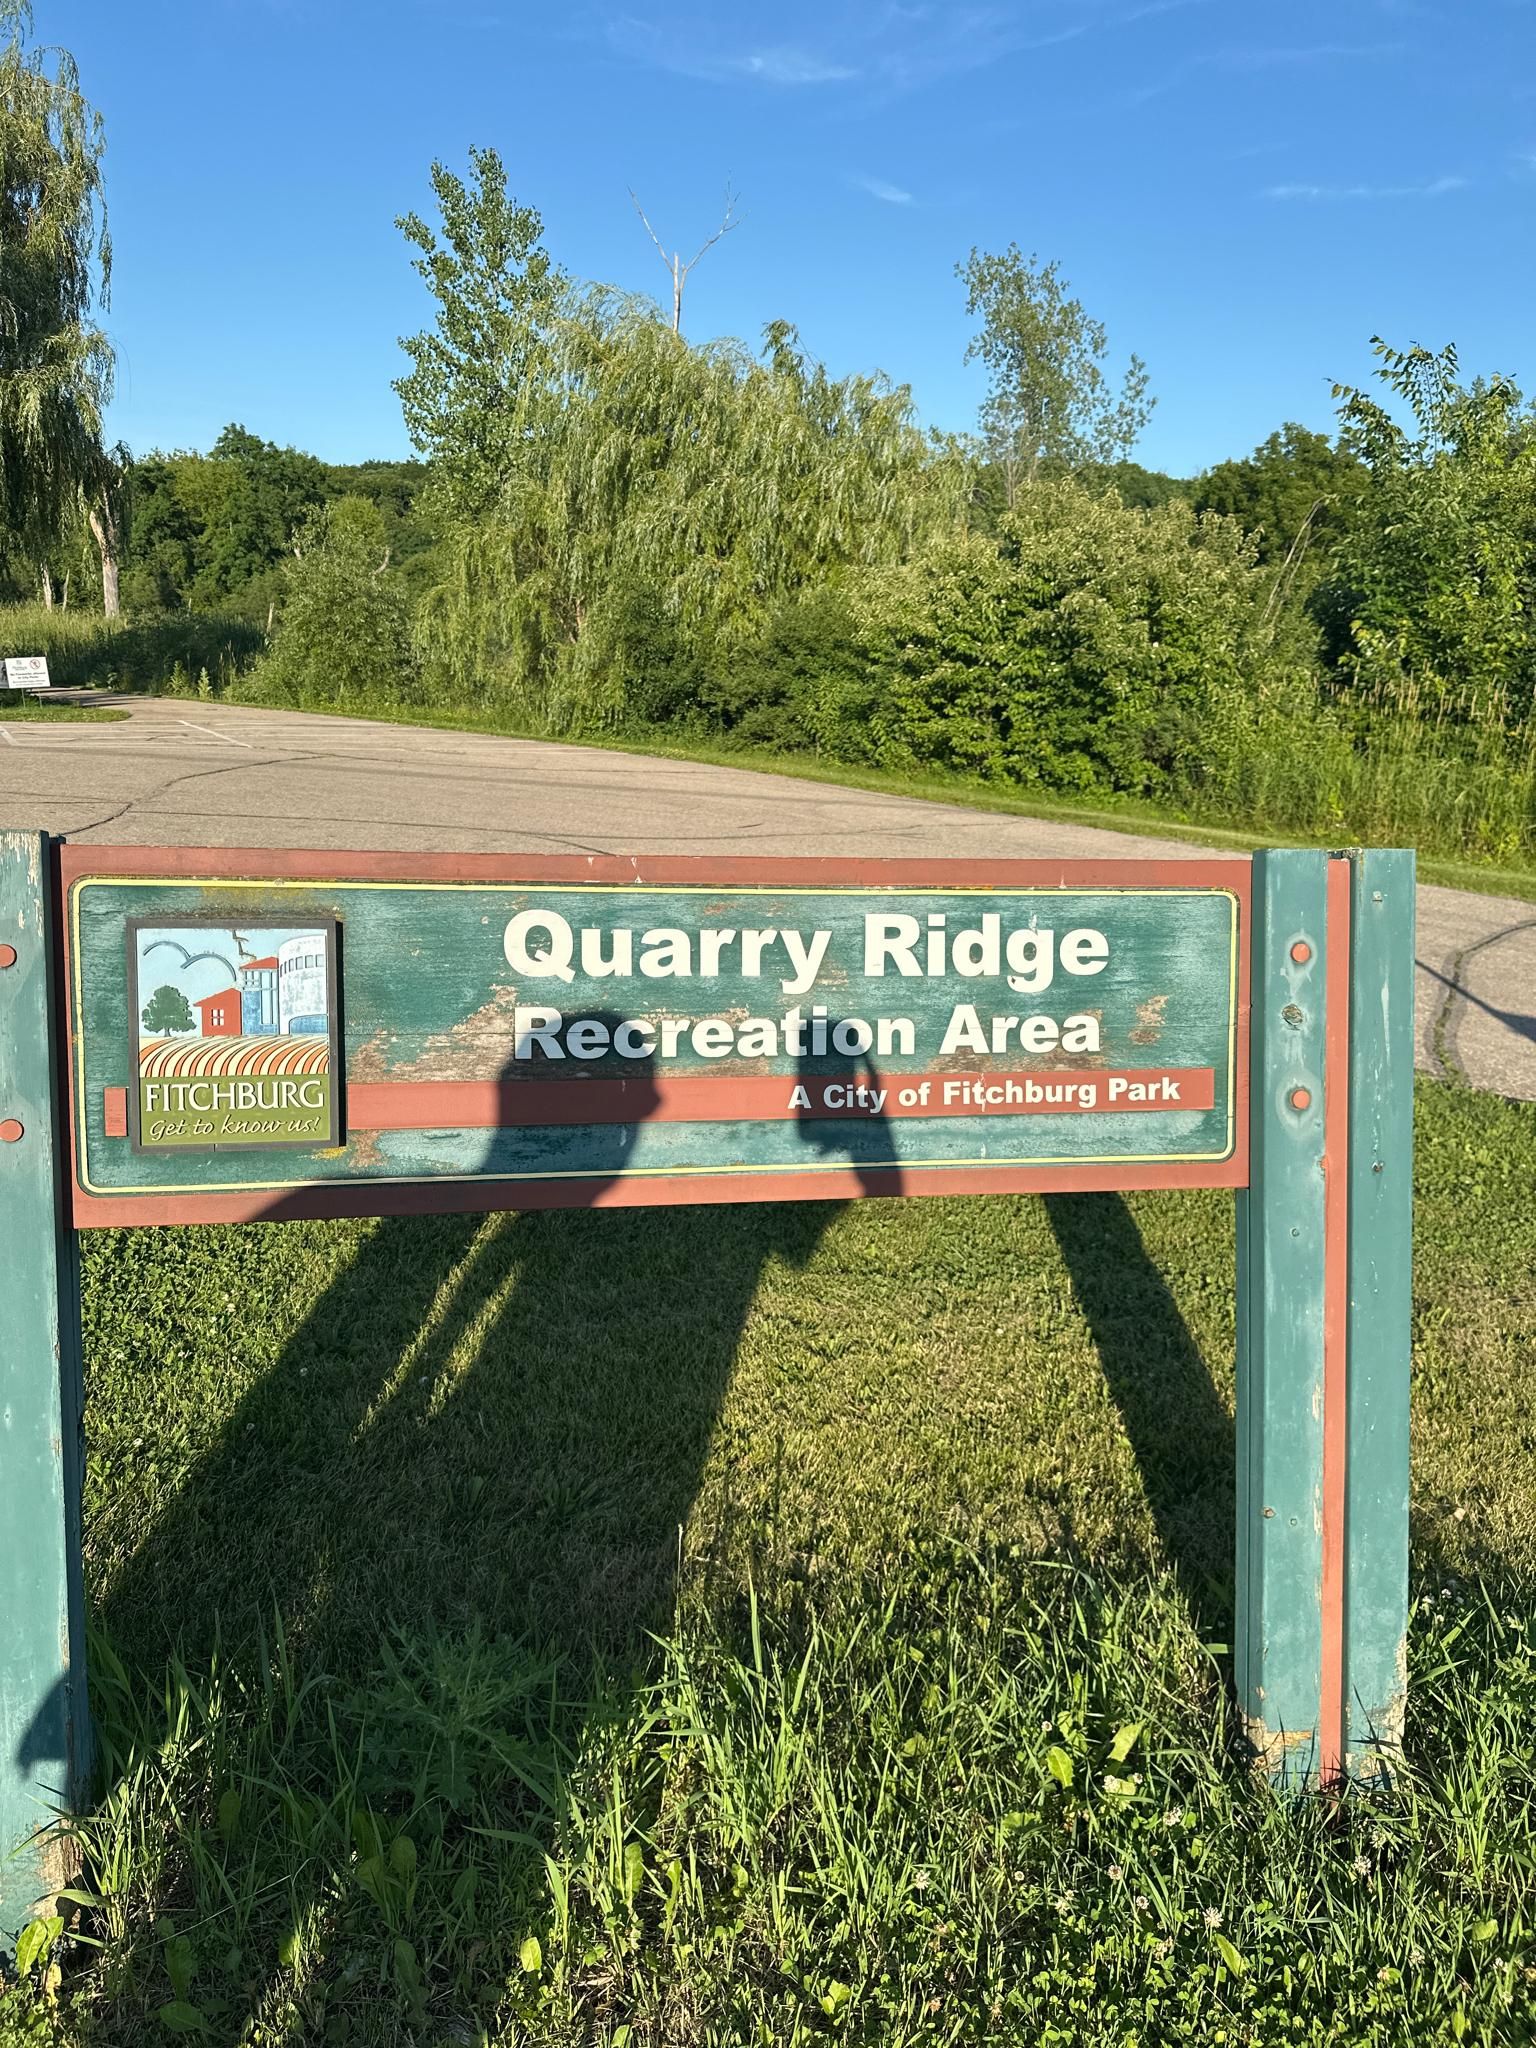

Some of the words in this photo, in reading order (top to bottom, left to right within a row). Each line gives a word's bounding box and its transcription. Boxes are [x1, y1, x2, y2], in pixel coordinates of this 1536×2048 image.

[504, 909, 832, 994] Quarry
[864, 913, 1109, 992] Ridge
[514, 1006, 915, 1060] Recreation
[939, 1004, 1100, 1055] Area
[145, 1080, 324, 1112] FITCHBURG
[788, 1085, 812, 1109] A
[823, 1084, 888, 1113] City
[898, 1082, 931, 1107] of
[943, 1079, 1097, 1109] Fitchburg
[1108, 1077, 1180, 1101] Park
[150, 1119, 187, 1141] Get
[193, 1119, 215, 1135] to
[220, 1114, 284, 1134] know
[287, 1116, 321, 1133] us!
